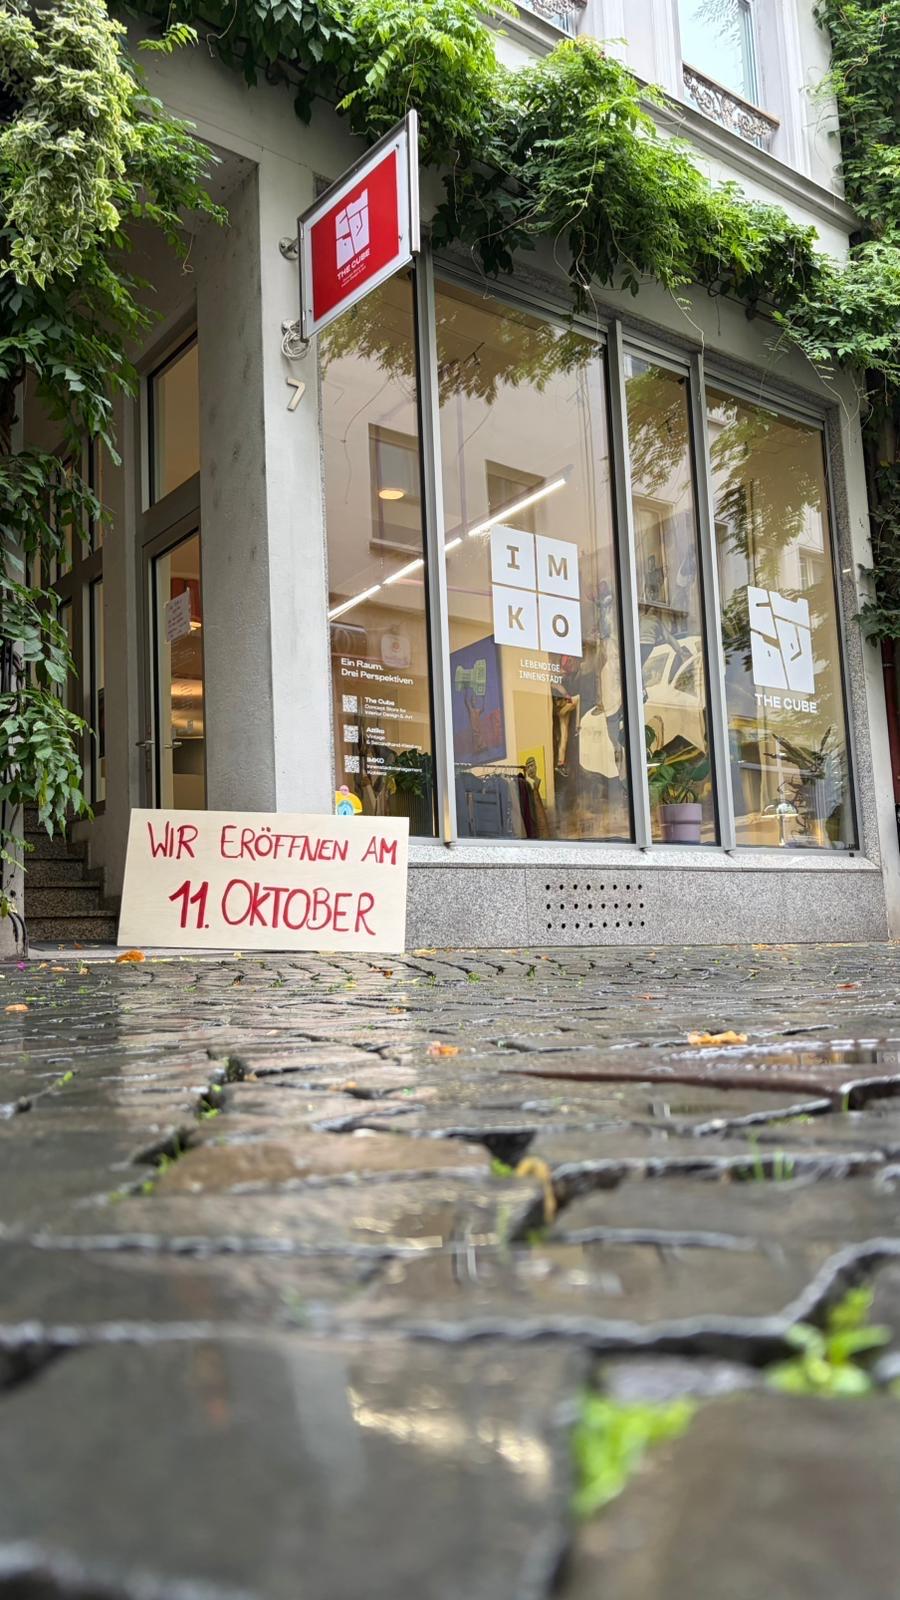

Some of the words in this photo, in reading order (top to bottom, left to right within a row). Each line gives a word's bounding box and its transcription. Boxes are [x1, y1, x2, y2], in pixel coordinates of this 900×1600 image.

[337, 264, 351, 280] THE
[351, 248, 370, 268] CUBE
[287, 377, 305, 411] 7
[341, 658, 355, 667] Ein
[356, 660, 384, 671] Raum.
[520, 659, 560, 672] LEBENDIGE
[341, 668, 359, 678] Drei
[360, 671, 414, 685] Perspektiven
[519, 670, 563, 683] INNENSTADT
[364, 696, 377, 704] The
[378, 698, 395, 706] Cube
[754, 693, 781, 709] THE
[783, 697, 818, 713] CUBE
[147, 821, 199, 860] WIR
[220, 825, 349, 861] ERÖFFNEN
[361, 835, 398, 865] AM
[168, 879, 210, 929] 11.
[221, 878, 377, 936] OKTOBER
